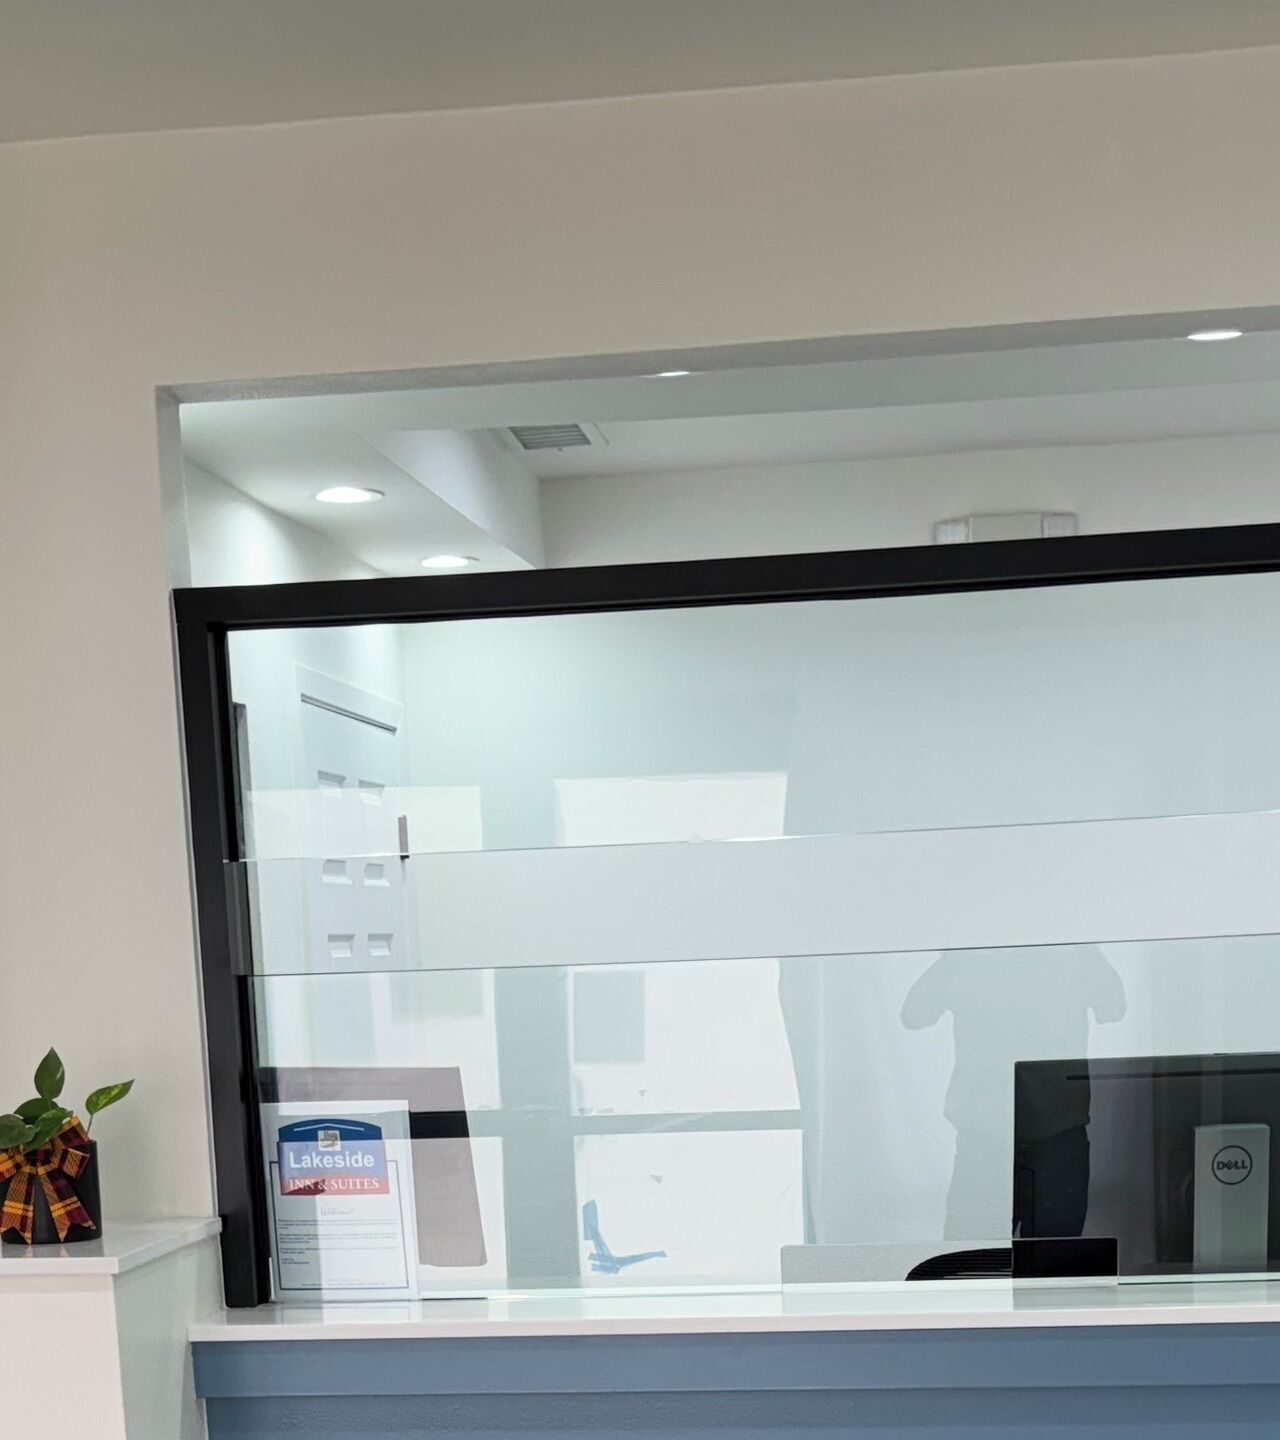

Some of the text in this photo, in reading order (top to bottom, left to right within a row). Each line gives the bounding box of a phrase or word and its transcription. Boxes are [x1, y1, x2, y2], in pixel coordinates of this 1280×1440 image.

[289, 1151, 375, 1168] Lakeside
[1217, 1160, 1248, 1170] DELL
[288, 1177, 380, 1191] INN & SUITES
